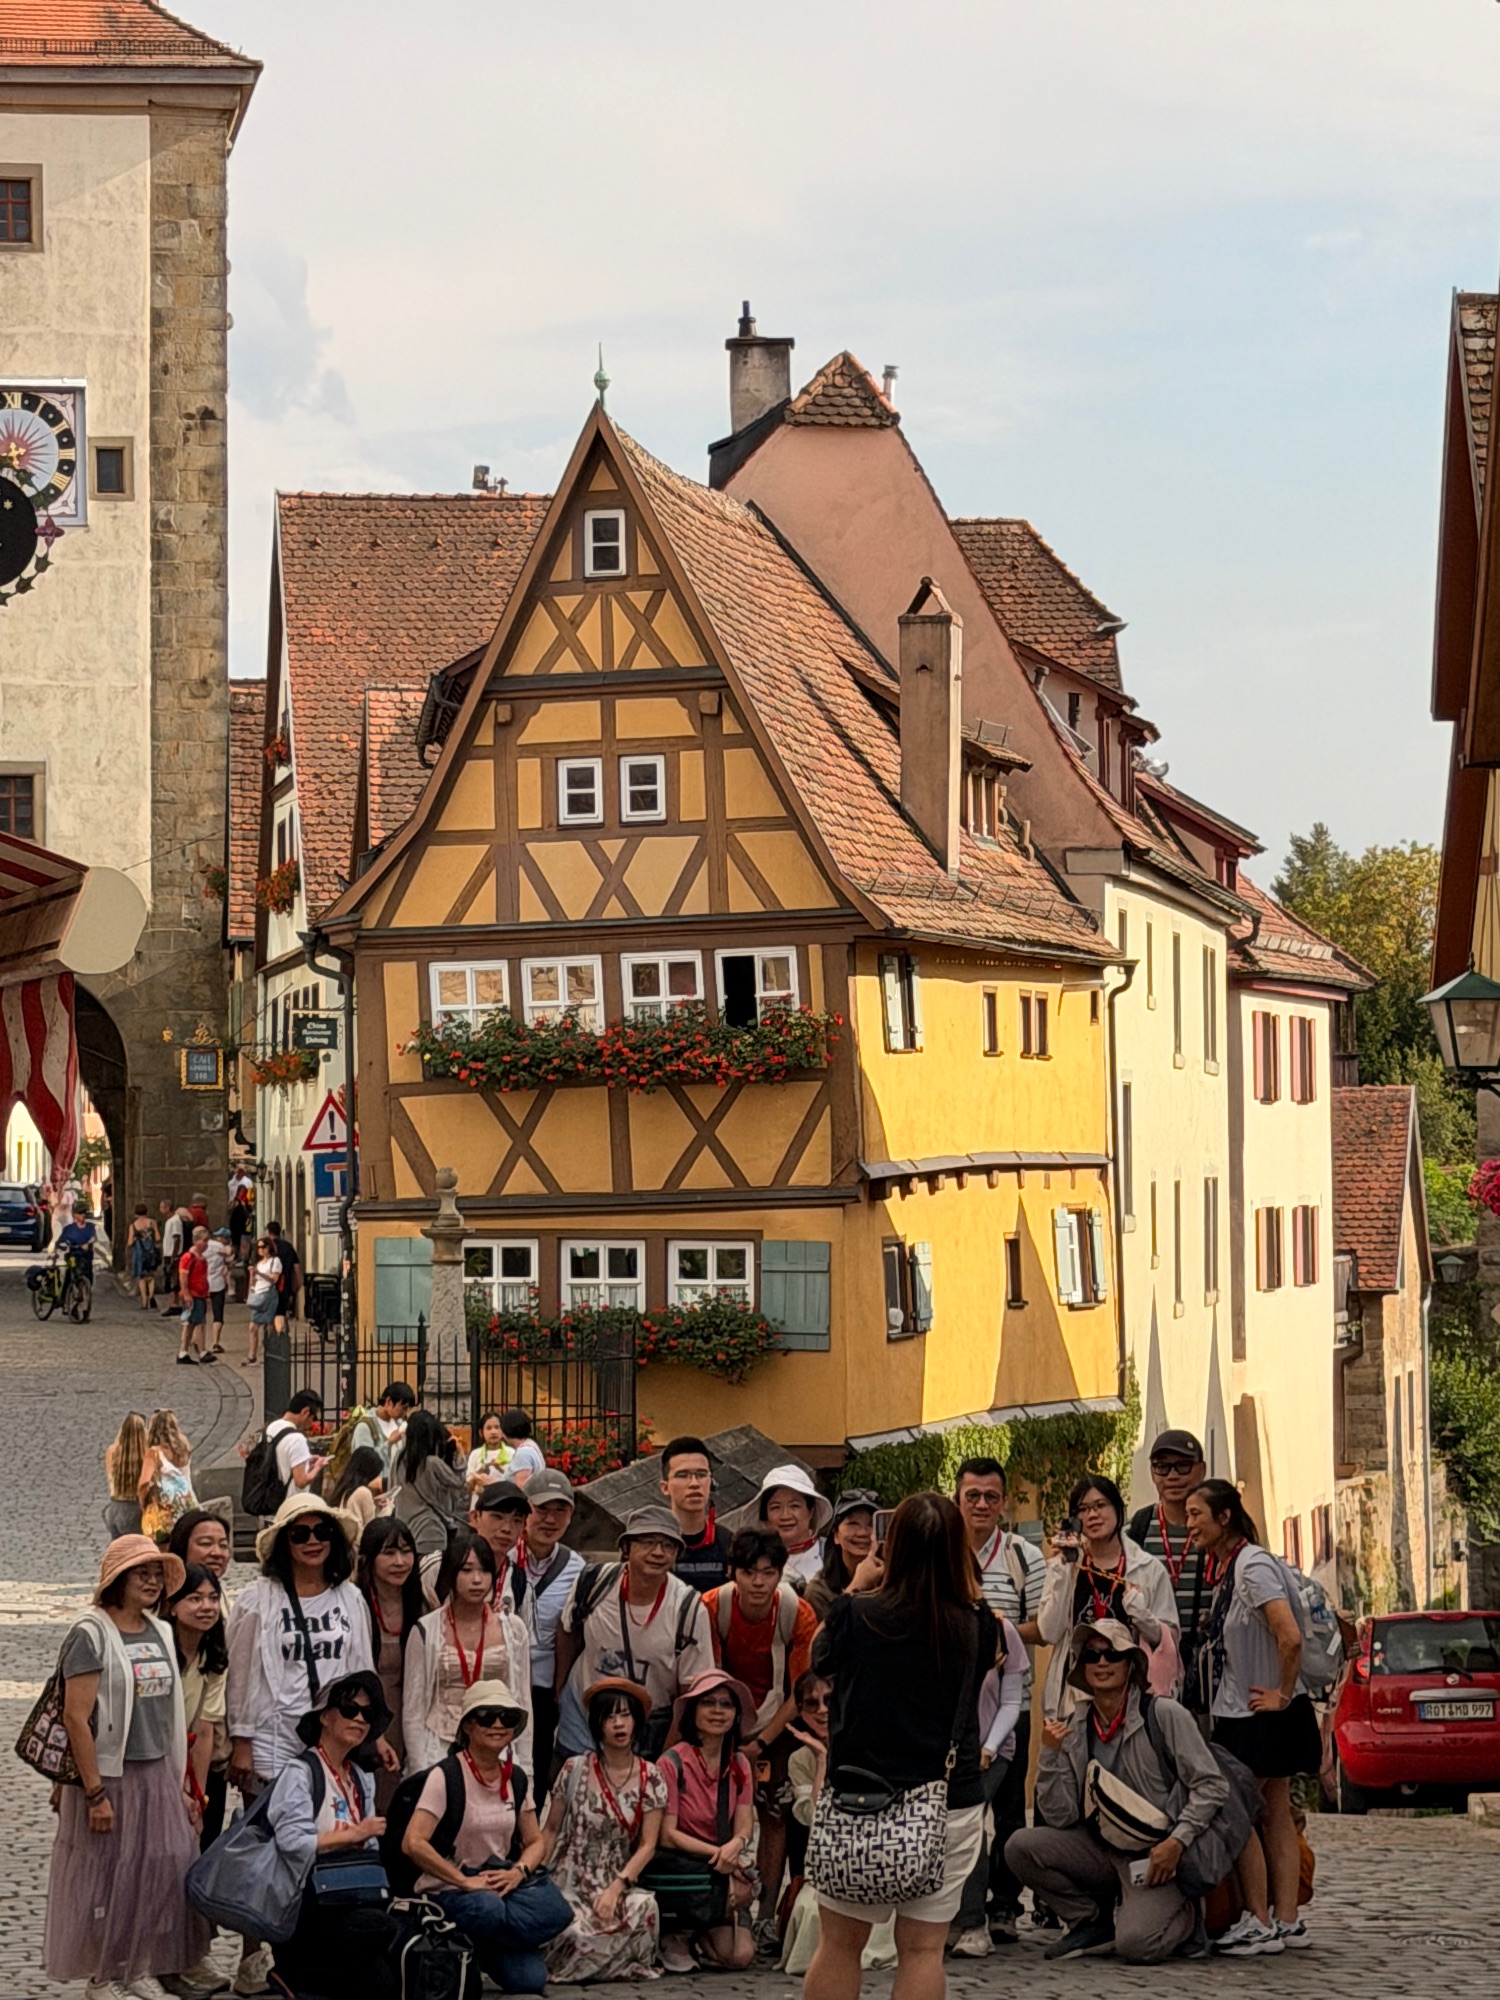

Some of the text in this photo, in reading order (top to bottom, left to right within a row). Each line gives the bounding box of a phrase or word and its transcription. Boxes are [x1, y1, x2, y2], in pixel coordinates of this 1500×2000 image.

[2, 392, 23, 409] XII
[279, 1606, 351, 1633] hat's
[1472, 1703, 1491, 1716] 997
